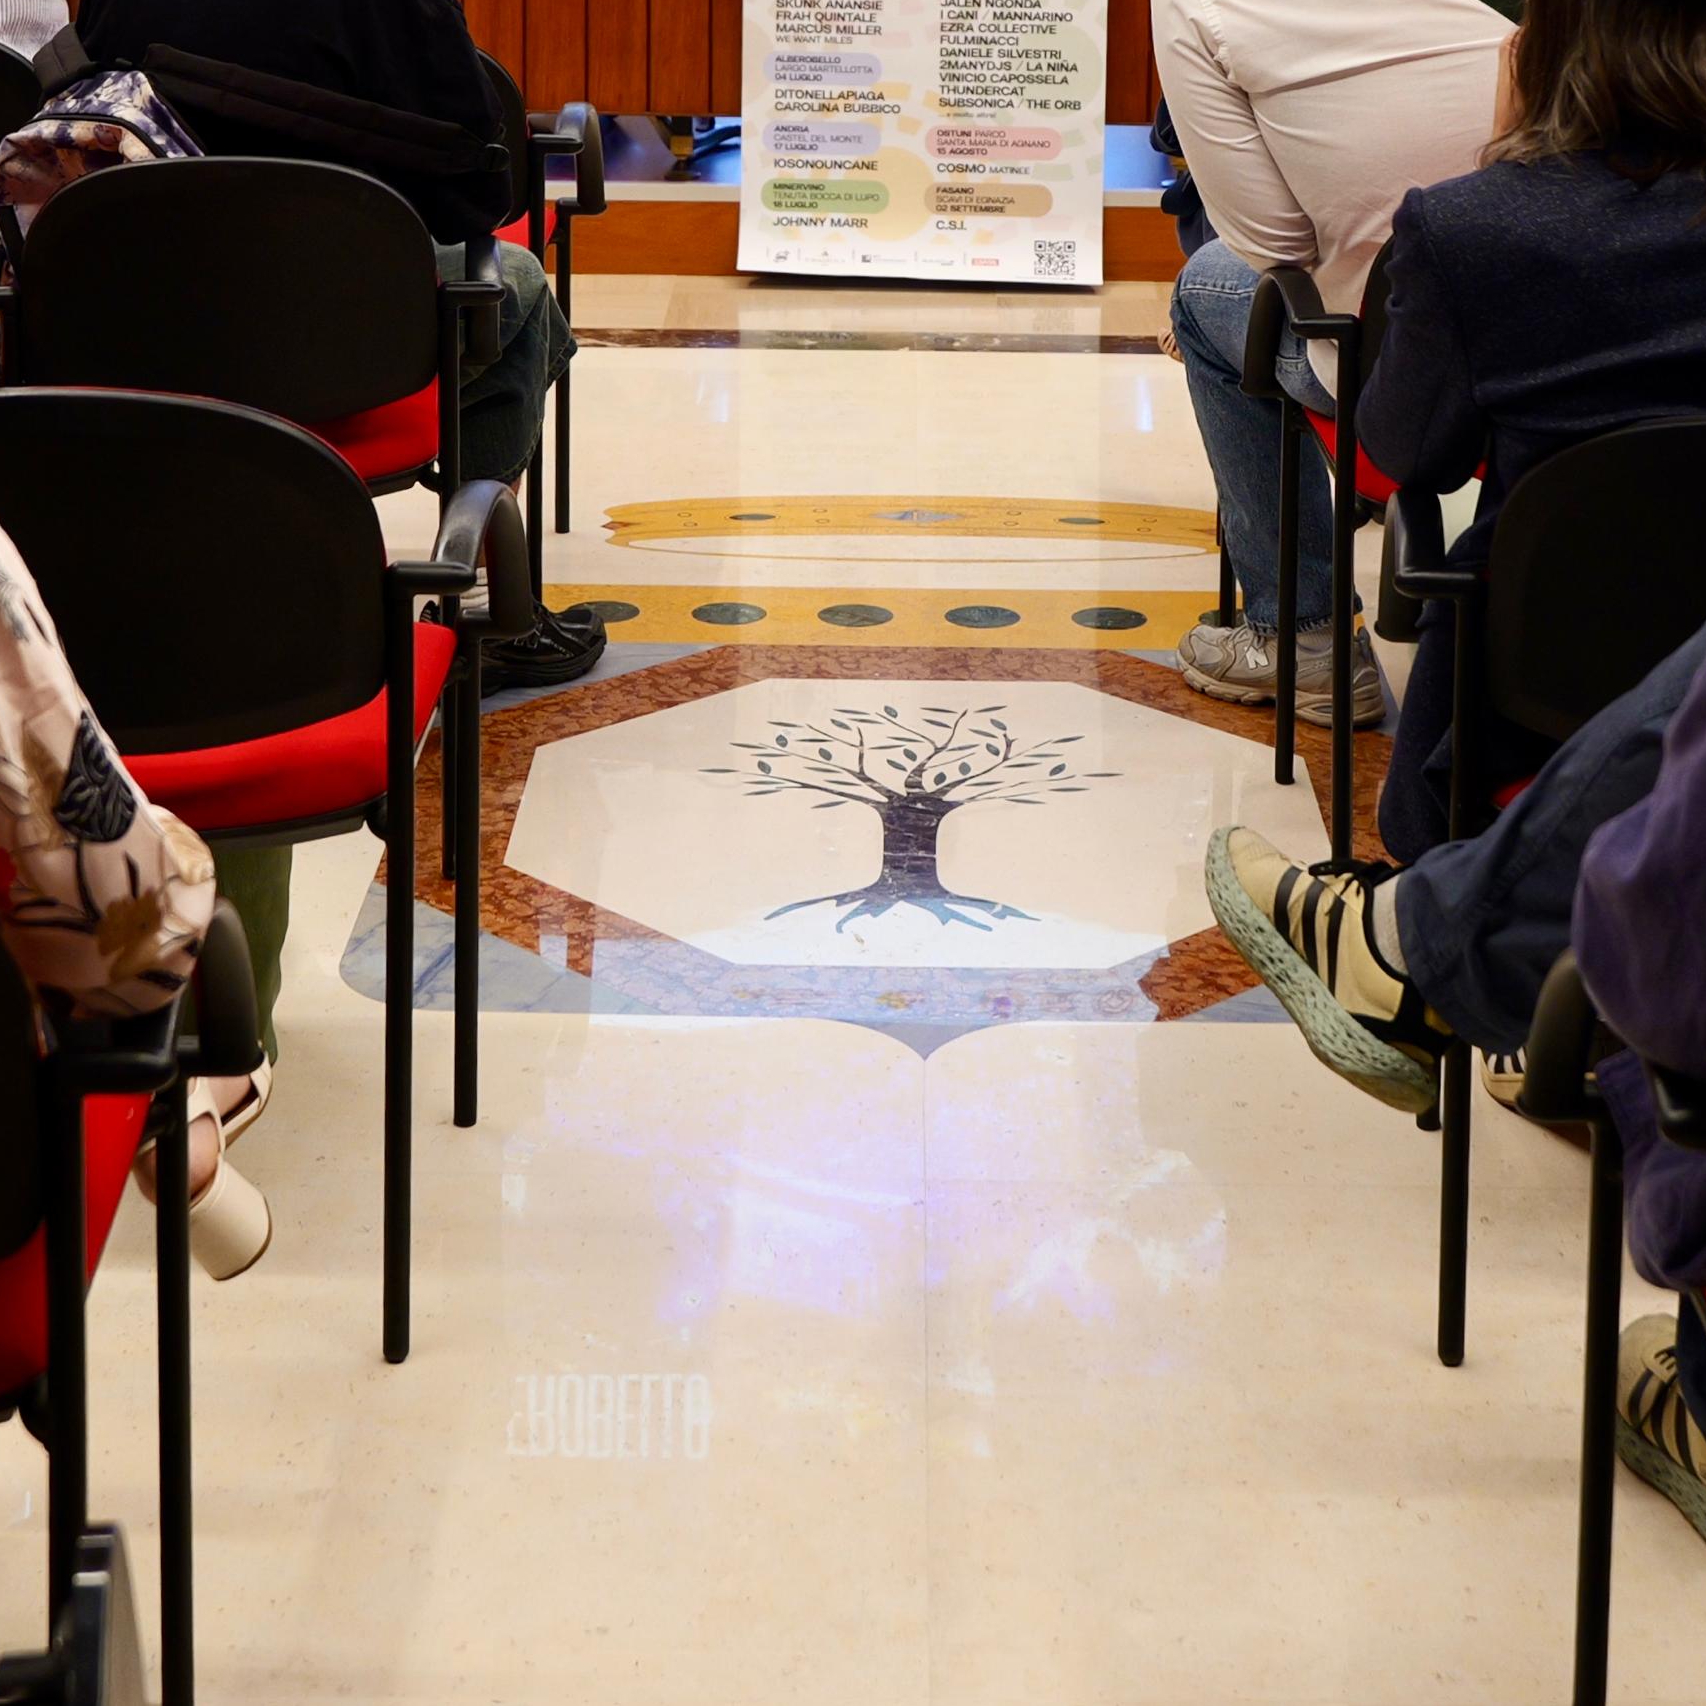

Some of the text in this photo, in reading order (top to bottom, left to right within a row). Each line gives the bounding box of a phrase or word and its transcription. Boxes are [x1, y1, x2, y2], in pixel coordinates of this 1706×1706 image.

[825, 0, 883, 10] ANANSIE
[776, 11, 877, 22] FRAH QUINTALE
[947, 10, 978, 20] CANI
[993, 12, 1073, 22] MANNARINO
[776, 24, 882, 36] MARCUS MILLER
[940, 22, 1057, 34] EZRA COLLECTIVE
[793, 36, 821, 44] WANT
[824, 36, 853, 44] MILES
[940, 35, 1019, 46] FULMINACCI
[939, 48, 1061, 60] DANIELE SILVESTRI
[939, 60, 1012, 71] 2MANYDJS
[1027, 61, 1043, 72] LA
[1047, 60, 1079, 72] NIÑA
[789, 74, 823, 82] LUGLIO
[939, 72, 1069, 84] VINICIO CAPOSSELA
[775, 89, 885, 101] DITONELLAPIAGA
[939, 84, 1027, 96] THUNDERCAT
[775, 102, 901, 114] CAROLINA BUBBICO
[939, 97, 1015, 108] SUBSONICA
[1027, 100, 1051, 110] THE
[1054, 100, 1081, 110] ORB
[810, 135, 827, 143] DEL
[830, 136, 863, 144] MONTE
[937, 130, 971, 138] OSTUNI
[949, 148, 987, 156] AGOSTO
[774, 158, 879, 170] IOSONOUNCANE
[937, 162, 986, 174] COSMO
[785, 201, 818, 209] LUGLIO
[773, 216, 868, 228] JOHNNY MARR
